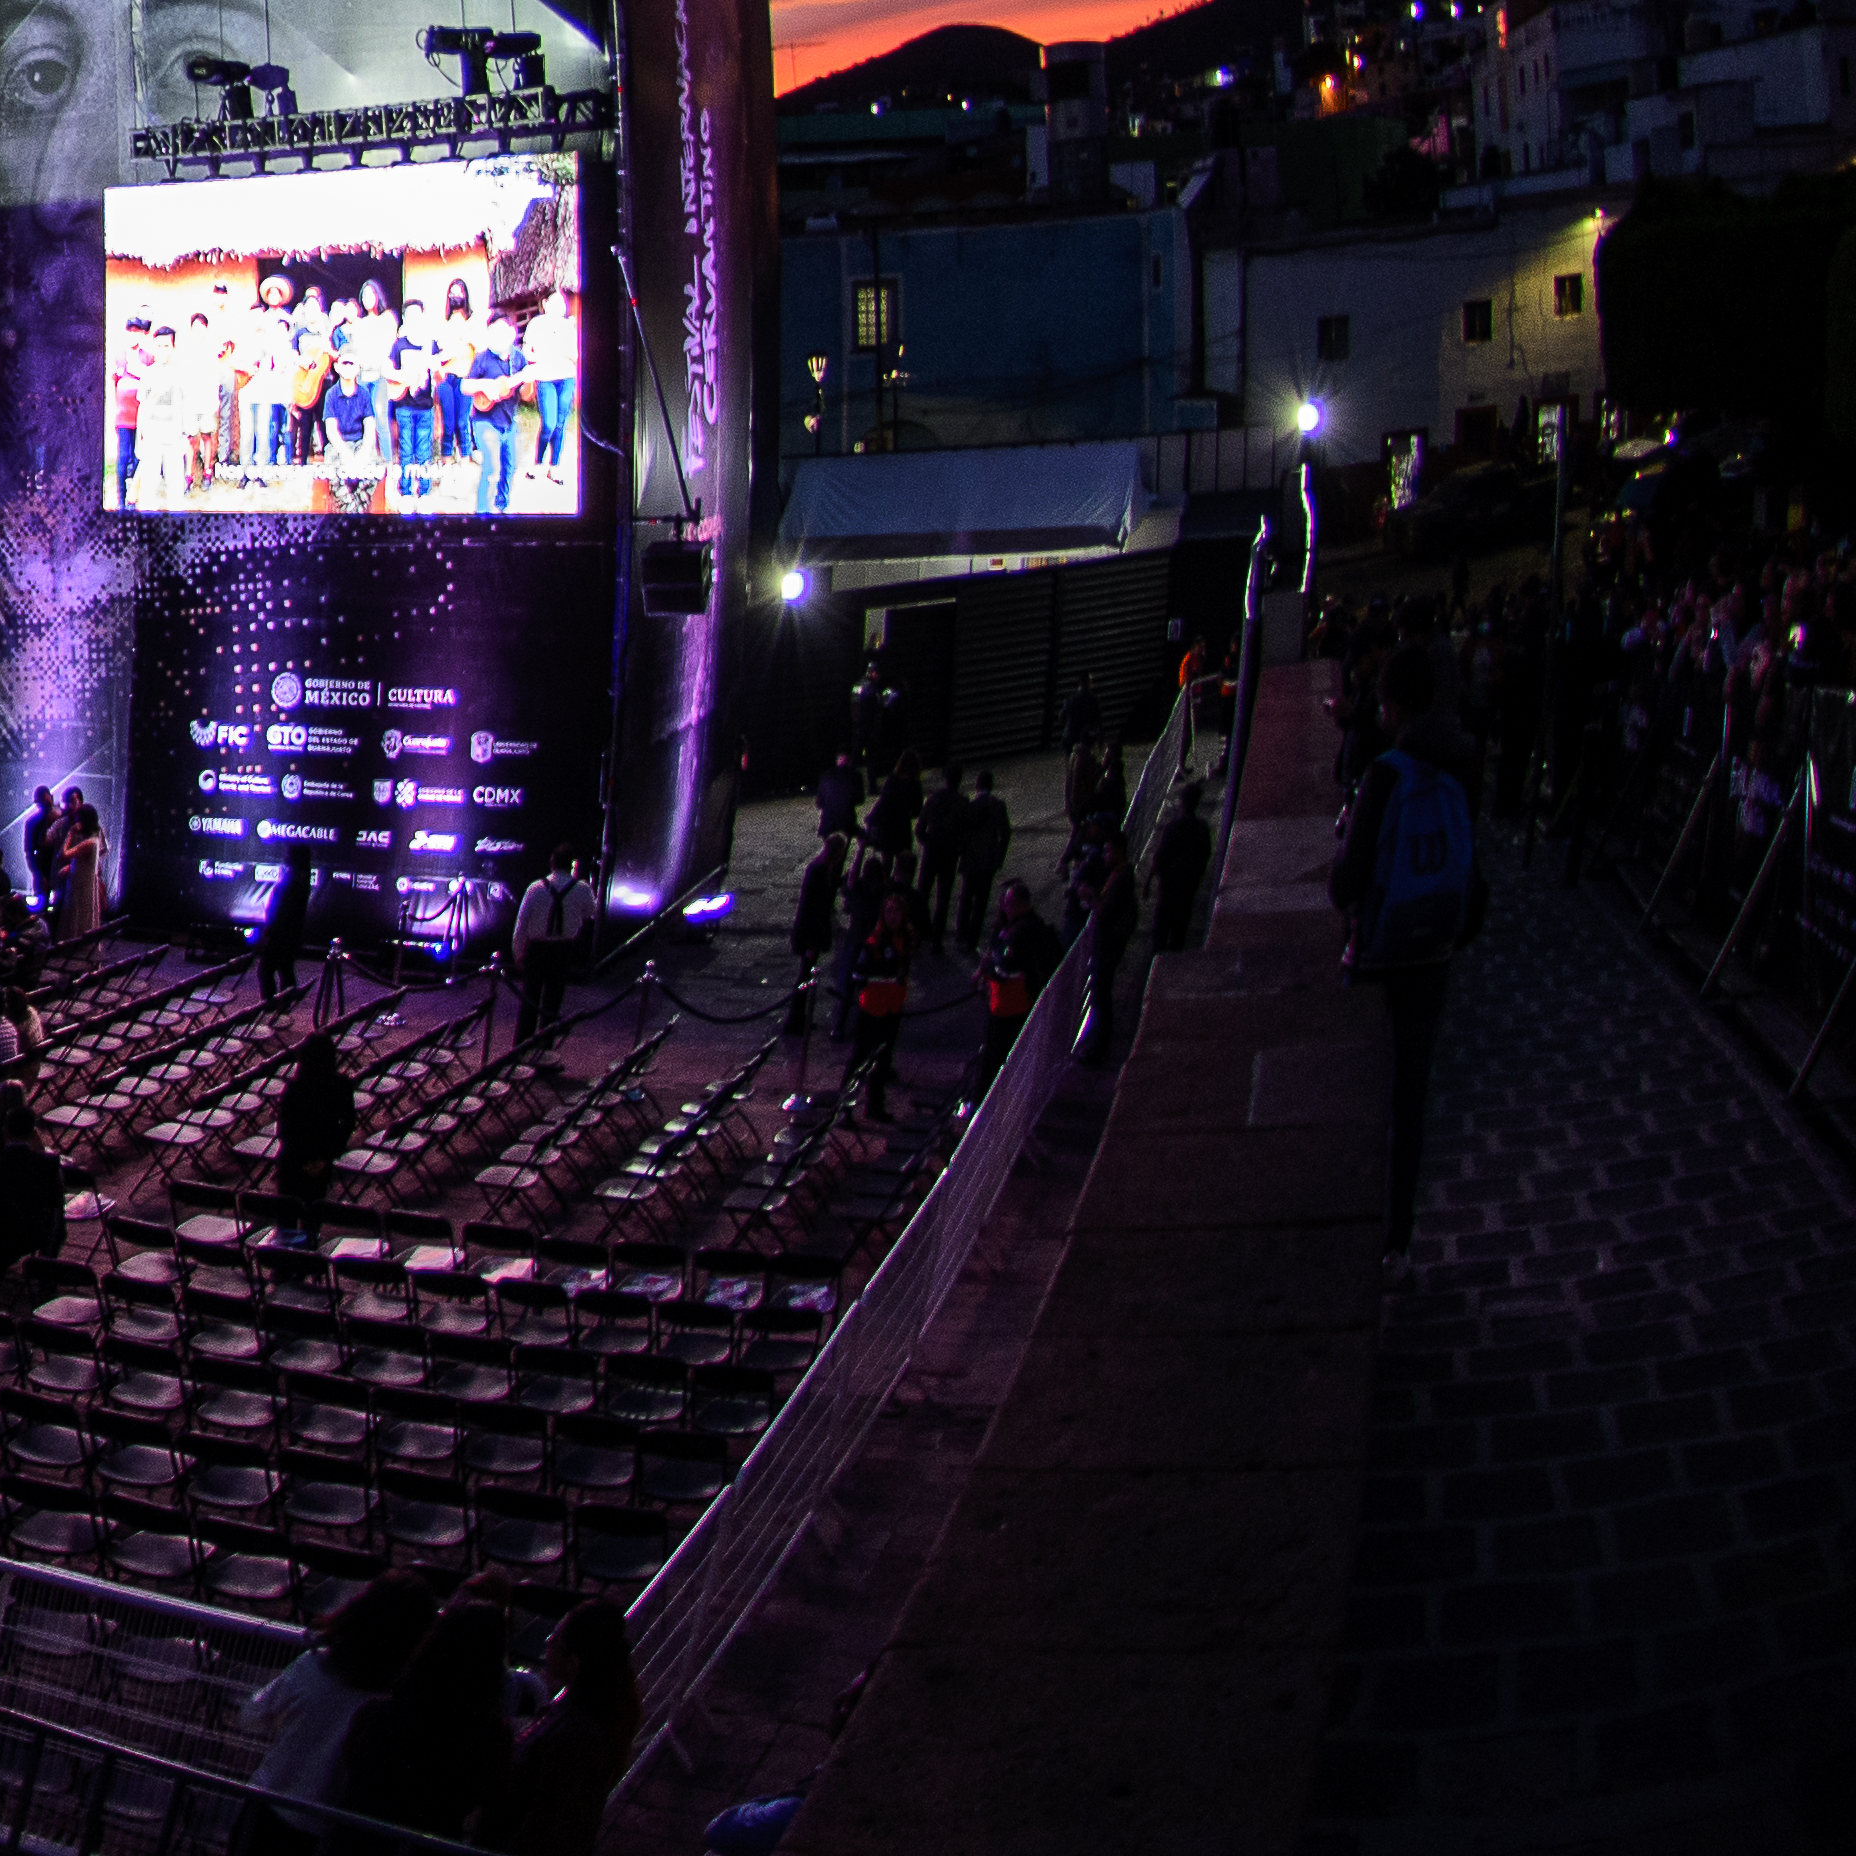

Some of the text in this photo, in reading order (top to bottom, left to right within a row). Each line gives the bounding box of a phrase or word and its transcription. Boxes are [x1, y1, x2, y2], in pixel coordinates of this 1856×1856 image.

[682, 253, 706, 481] FESTIVAL
[304, 677, 371, 691] GOBIERNO DE
[304, 690, 371, 707] MÉXICO
[388, 687, 456, 706] CULTURA
[217, 725, 249, 746] FIC
[266, 725, 308, 746] GTO
[473, 785, 522, 804] CDMX
[201, 817, 243, 836] YAMAHA
[270, 823, 338, 841] MEGACABLE
